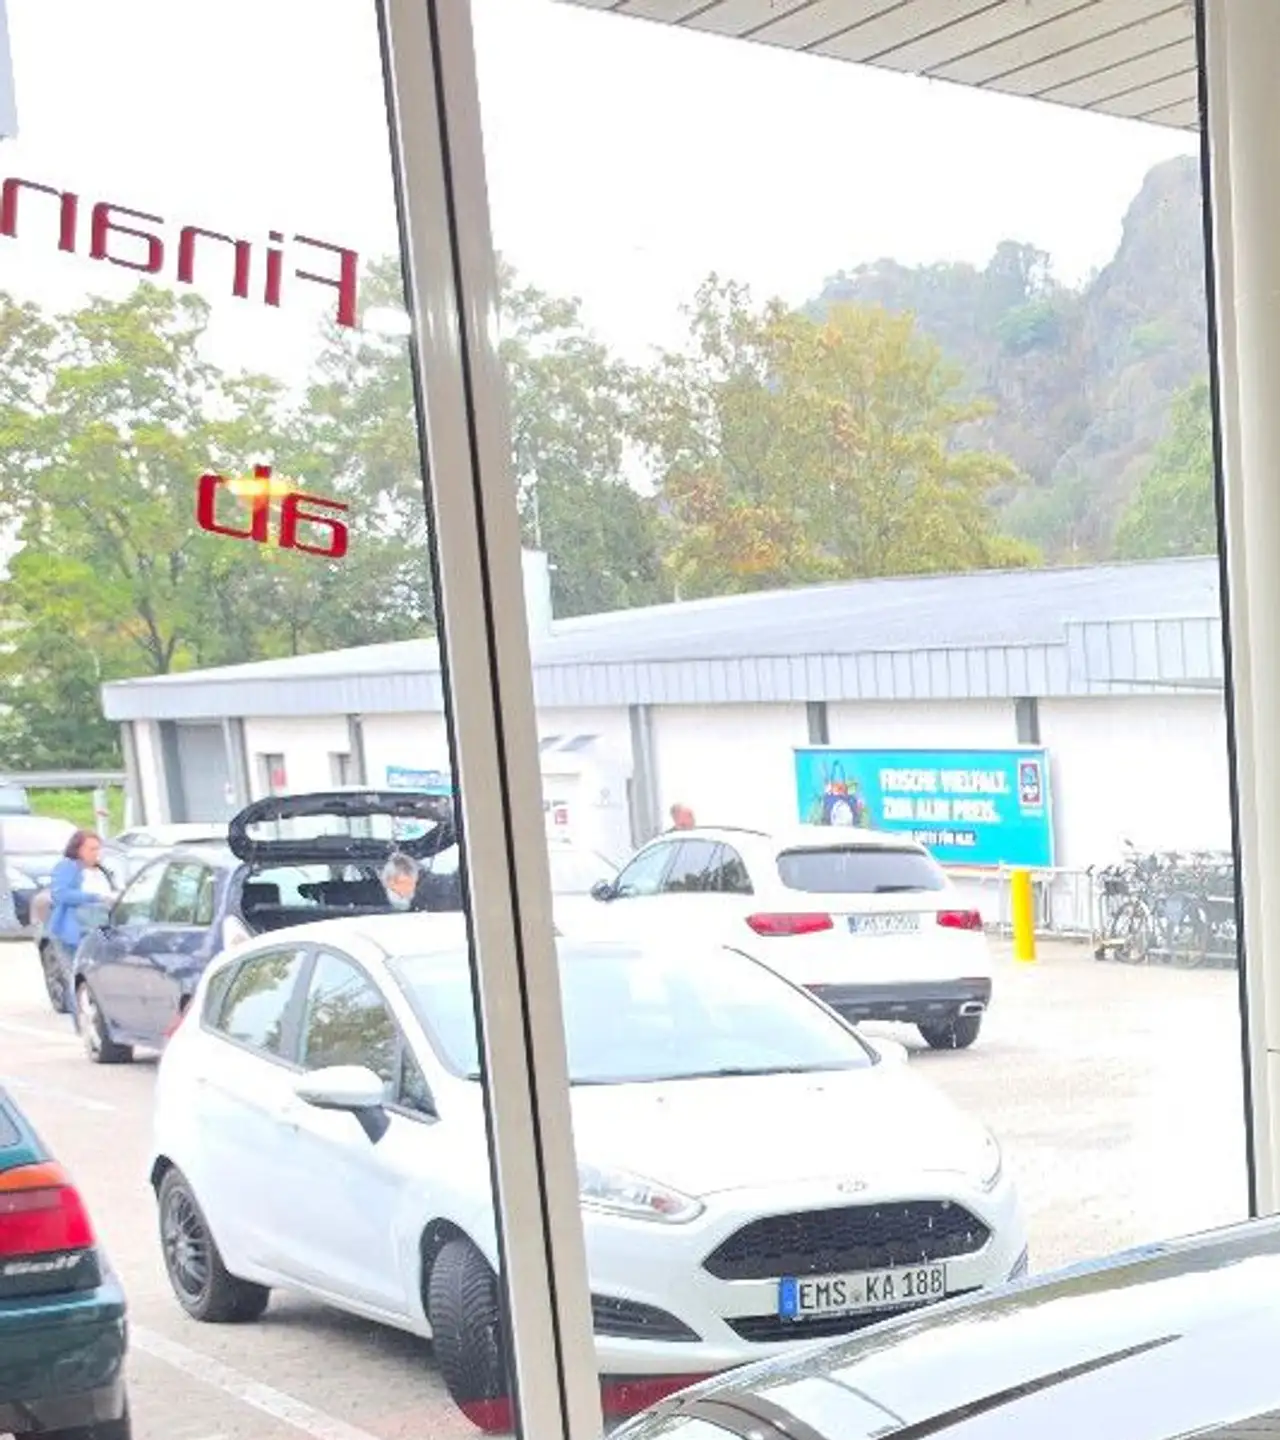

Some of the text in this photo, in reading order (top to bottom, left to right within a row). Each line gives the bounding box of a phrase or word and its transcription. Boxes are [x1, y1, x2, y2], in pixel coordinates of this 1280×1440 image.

[799, 1268, 943, 1309] EMS KA 188
